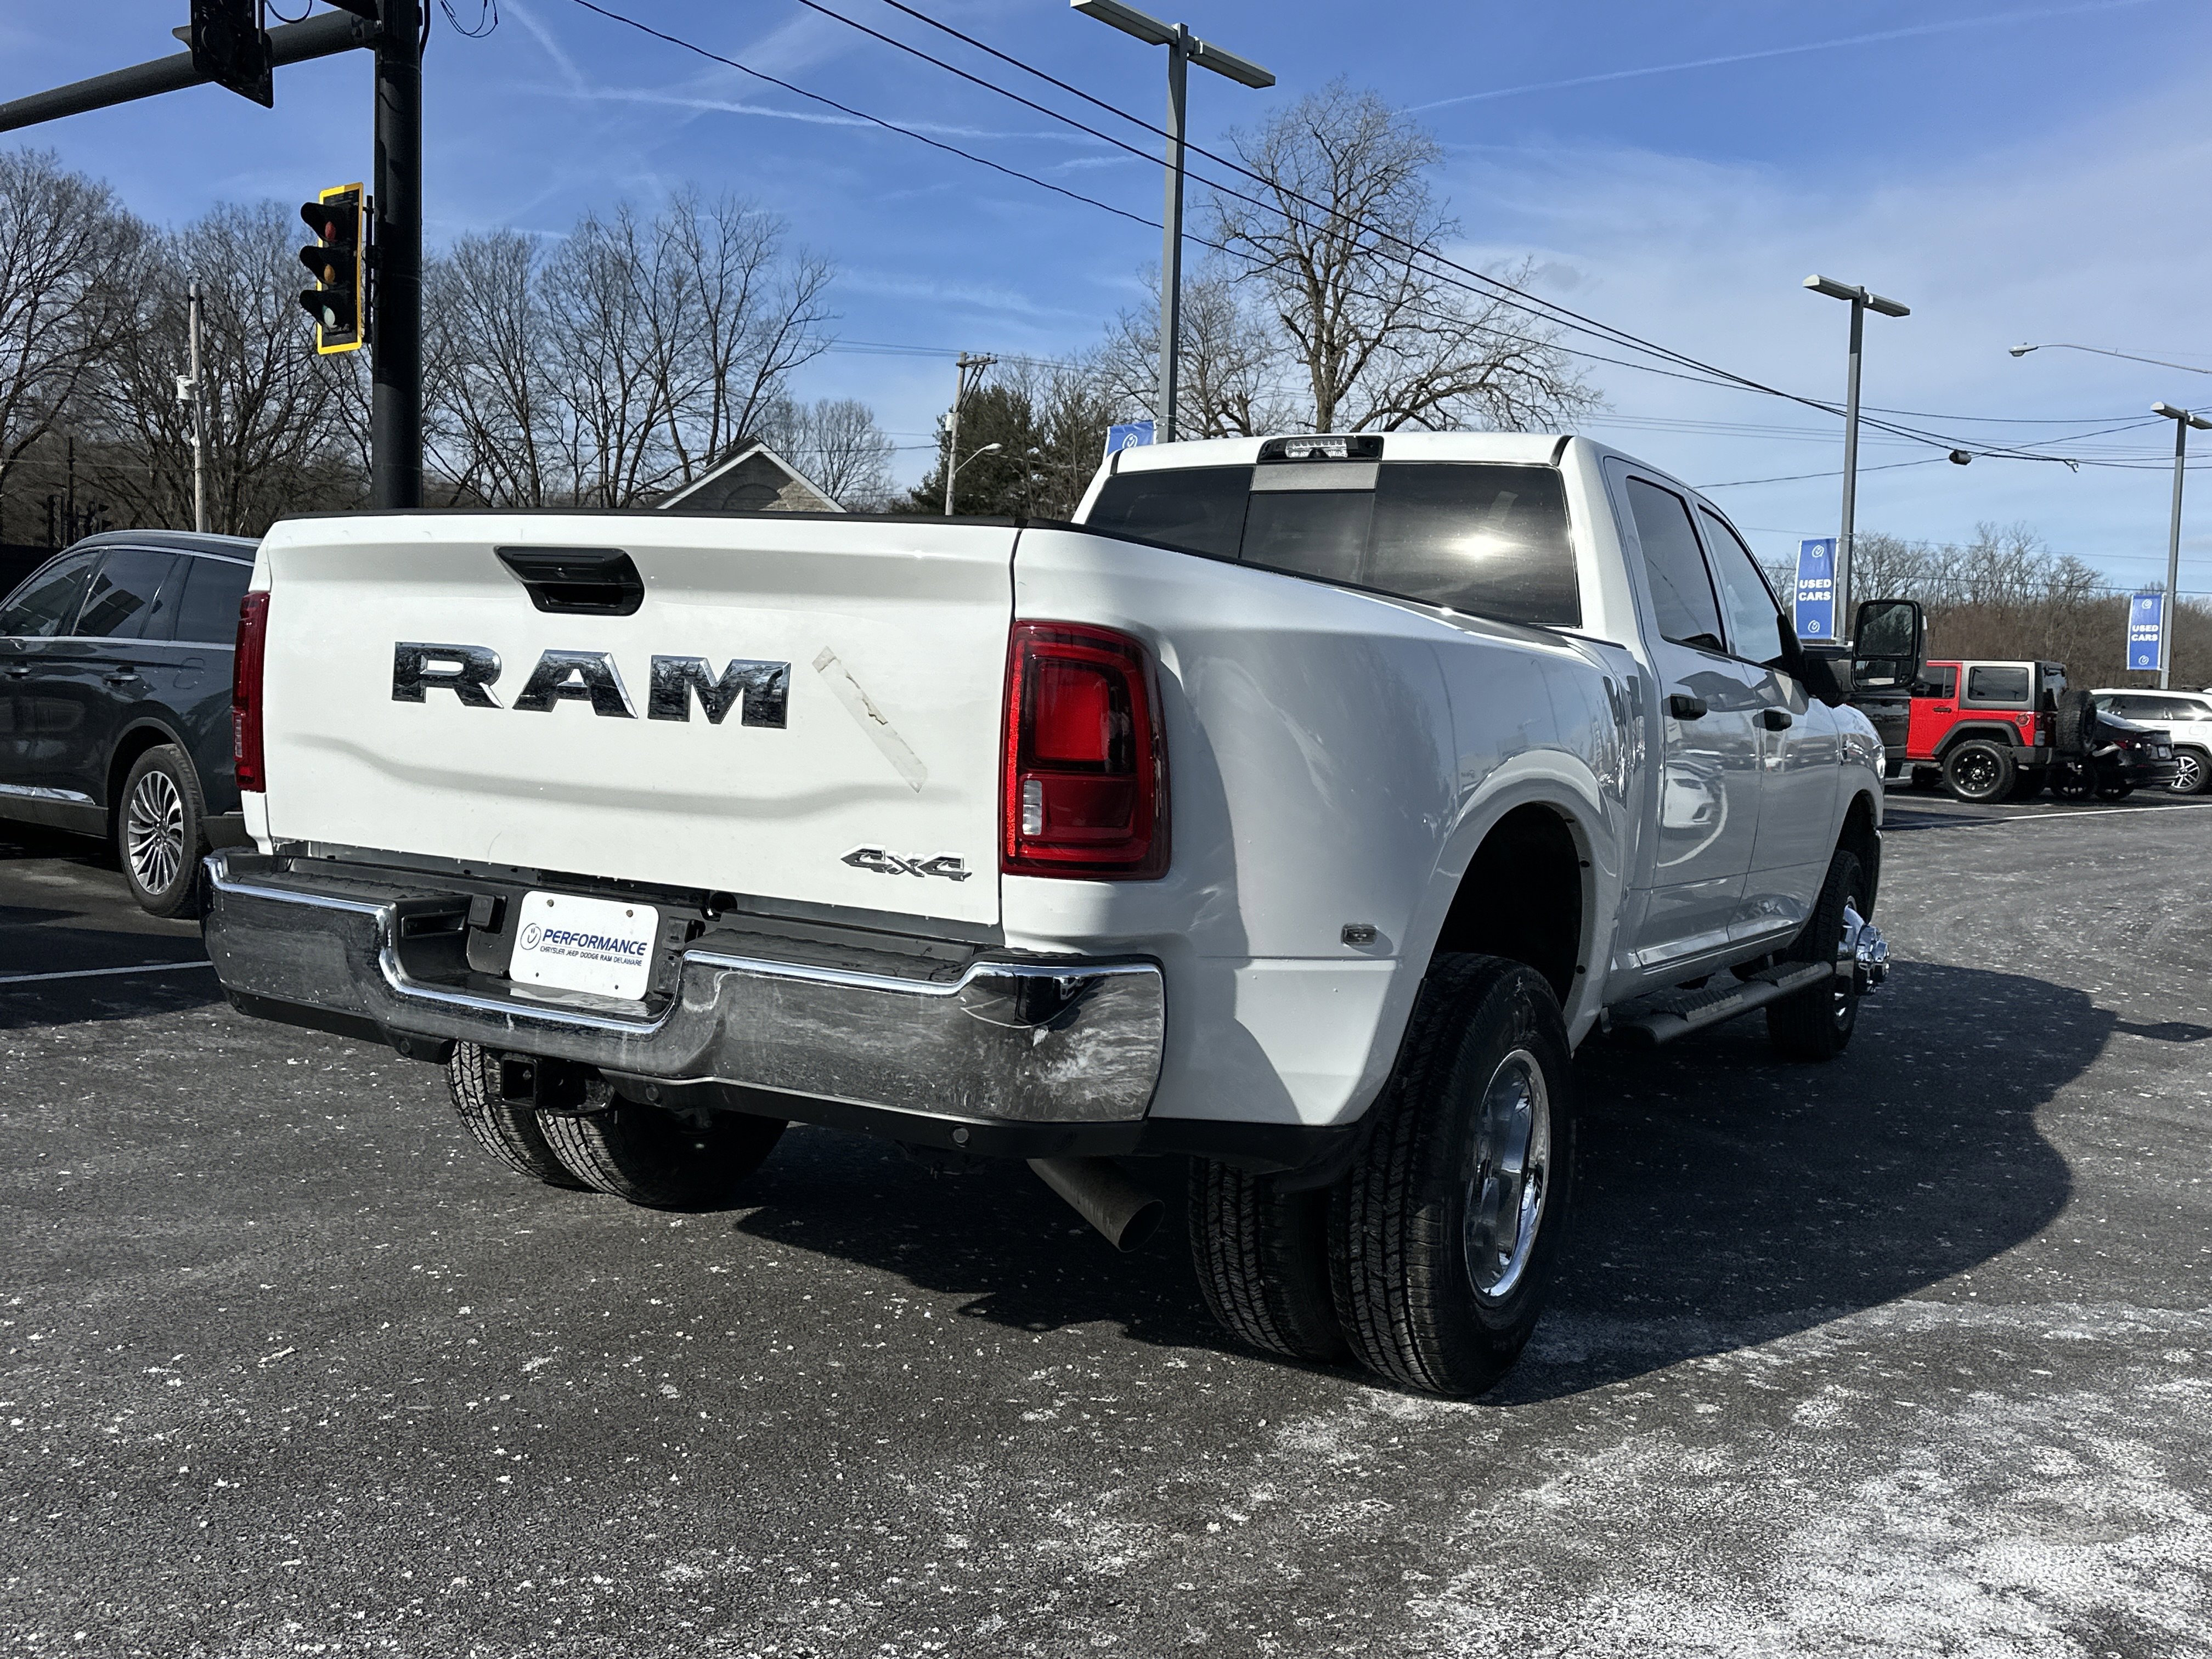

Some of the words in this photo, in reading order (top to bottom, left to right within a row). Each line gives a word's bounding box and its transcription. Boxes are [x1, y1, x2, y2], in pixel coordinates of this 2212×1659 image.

[1799, 579, 1832, 589] USED
[1798, 591, 1831, 601] CARS
[391, 641, 792, 730] RAM
[542, 929, 647, 956] PERFORMANCE
[540, 946, 565, 955] CHRYSLER
[580, 951, 599, 960] DODGE
[600, 954, 612, 962] RAM
[613, 956, 642, 967] DELAWARE
